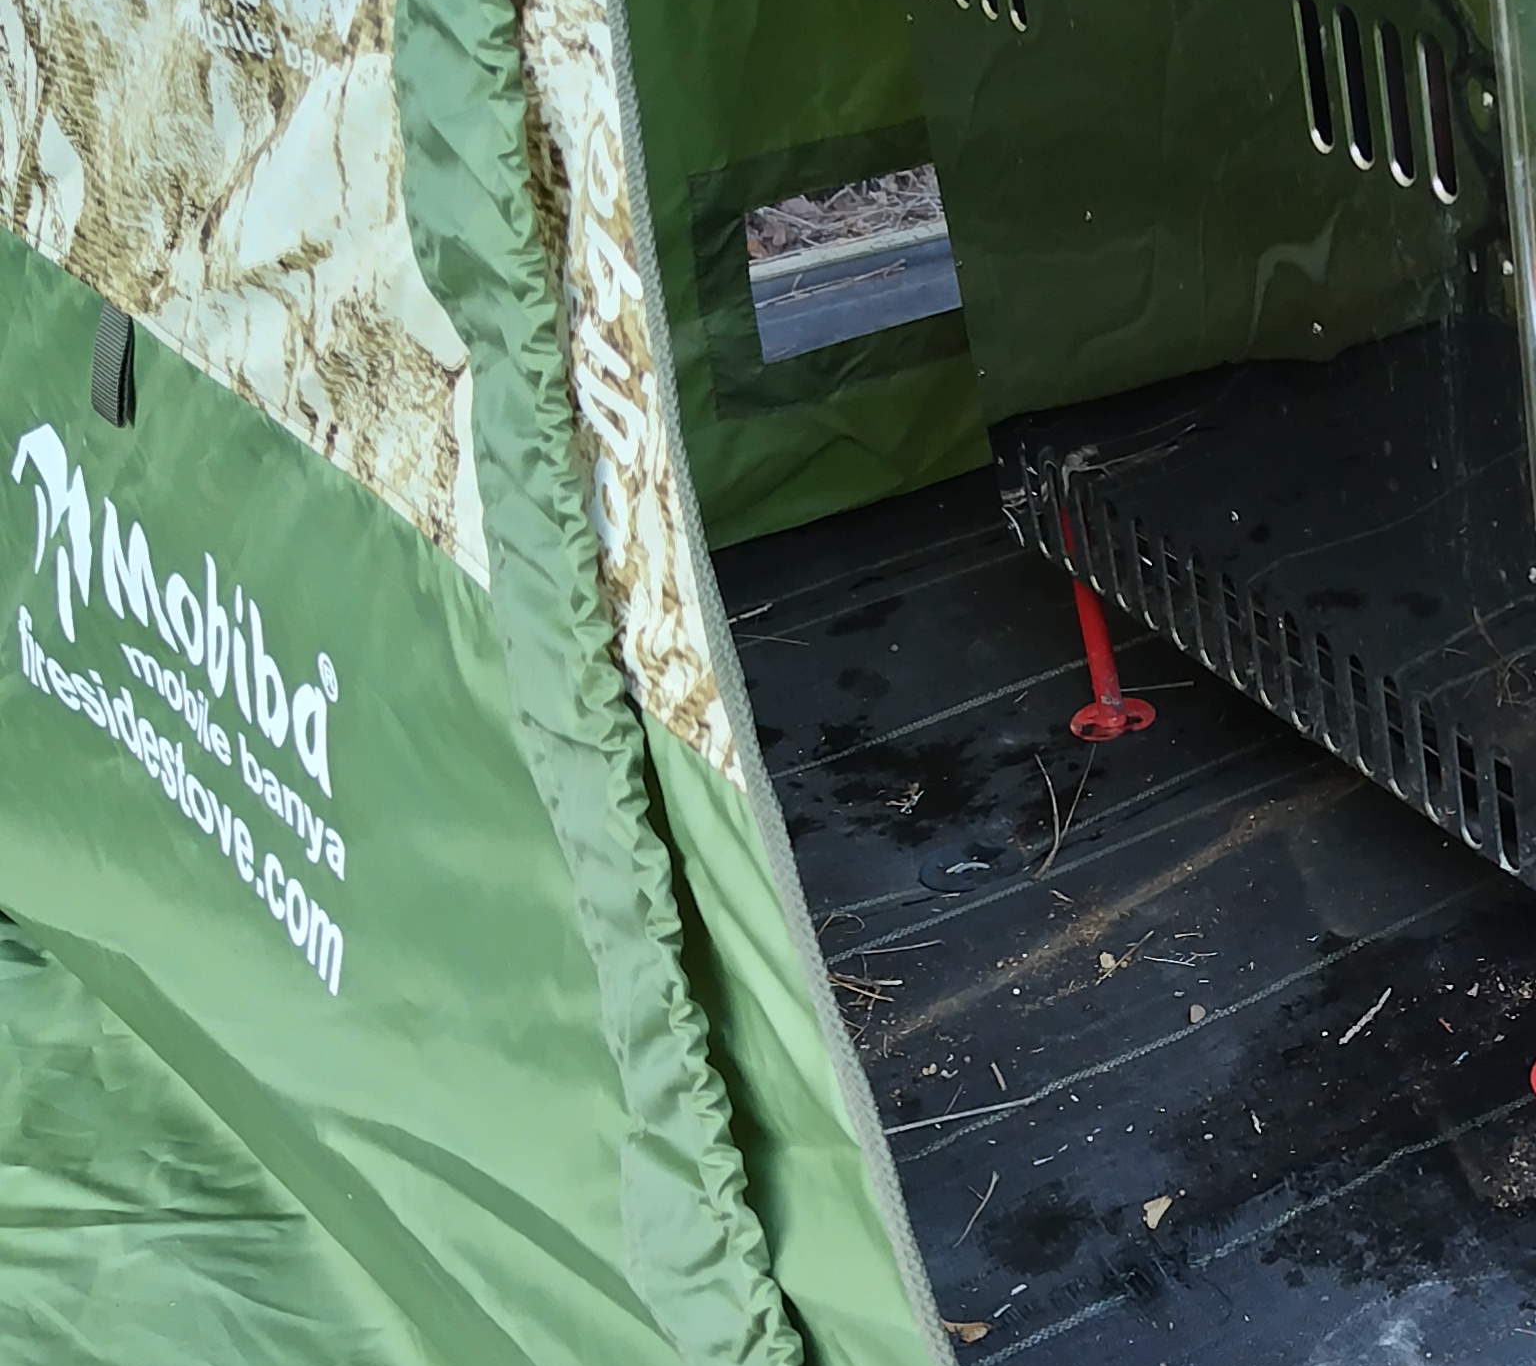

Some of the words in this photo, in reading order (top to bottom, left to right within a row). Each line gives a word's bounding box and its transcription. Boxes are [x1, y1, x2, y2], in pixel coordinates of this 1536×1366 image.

[18, 604, 344, 997] firesidestove.com
[121, 641, 232, 767] mobile
[238, 732, 346, 881] banya
